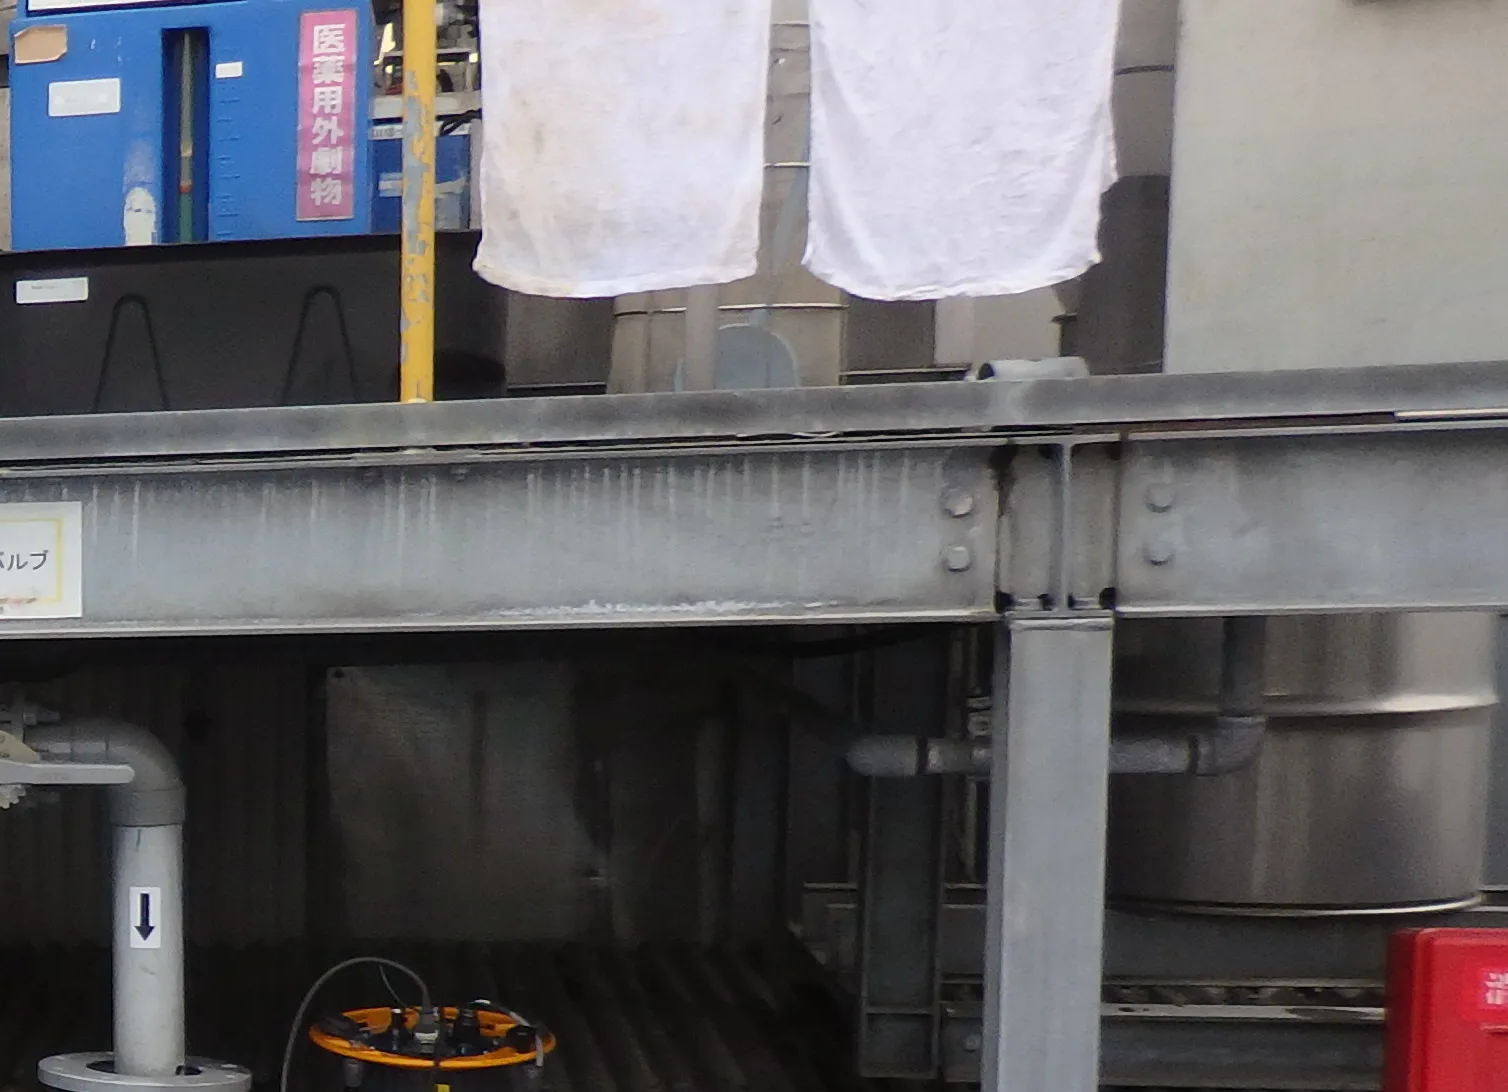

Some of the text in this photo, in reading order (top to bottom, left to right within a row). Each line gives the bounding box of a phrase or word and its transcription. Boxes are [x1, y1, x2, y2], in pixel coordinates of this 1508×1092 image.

[308, 23, 346, 207] 医薬用外劇物
